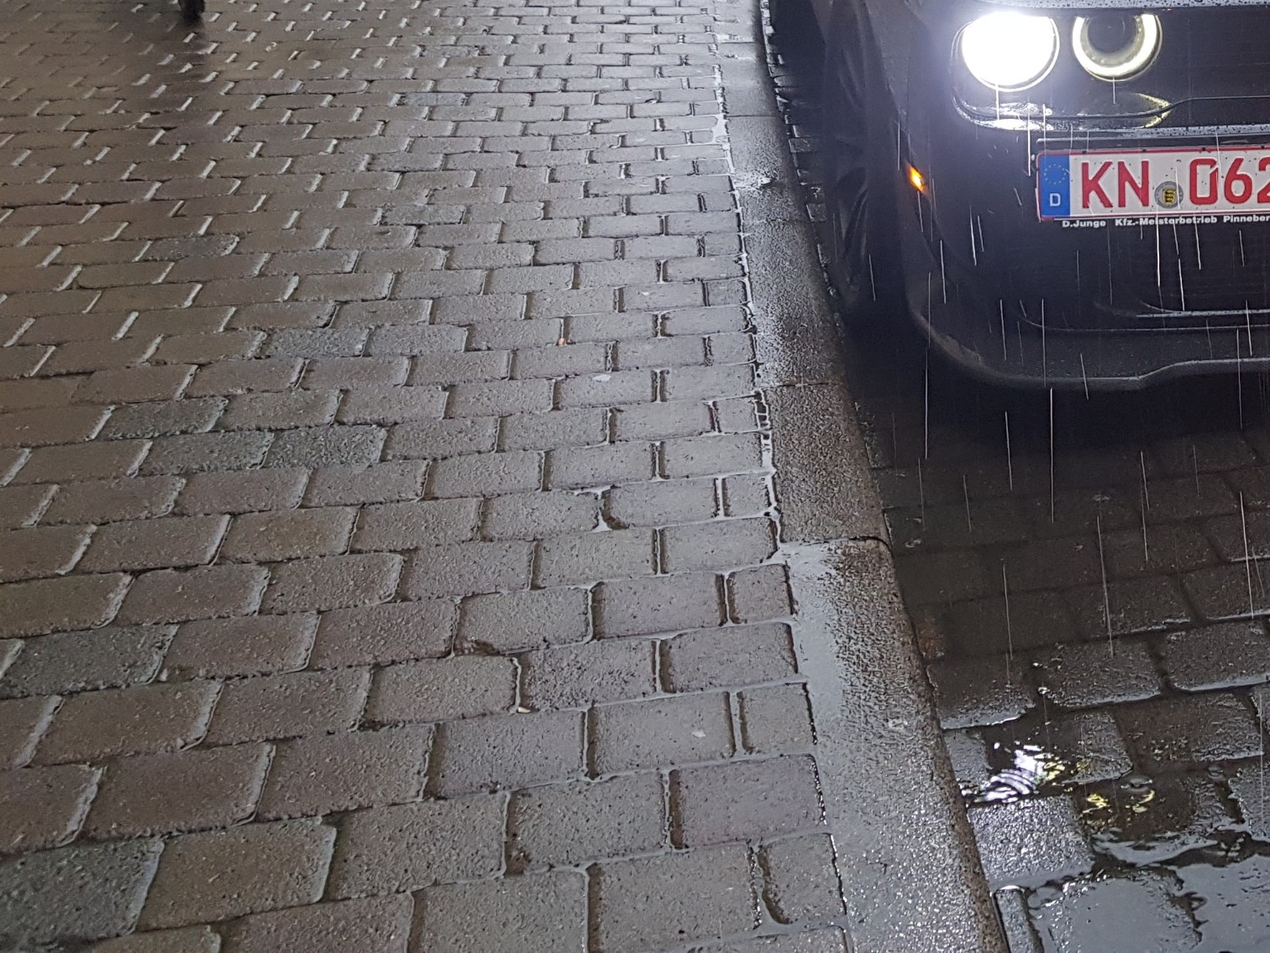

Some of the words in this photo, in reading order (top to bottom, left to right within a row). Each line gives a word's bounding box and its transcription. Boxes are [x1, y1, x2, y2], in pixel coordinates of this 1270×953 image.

[1081, 160, 1150, 209] KN
[1050, 193, 1061, 207] D
[1115, 214, 1217, 227] Kfz.-Meisterbetrieb
